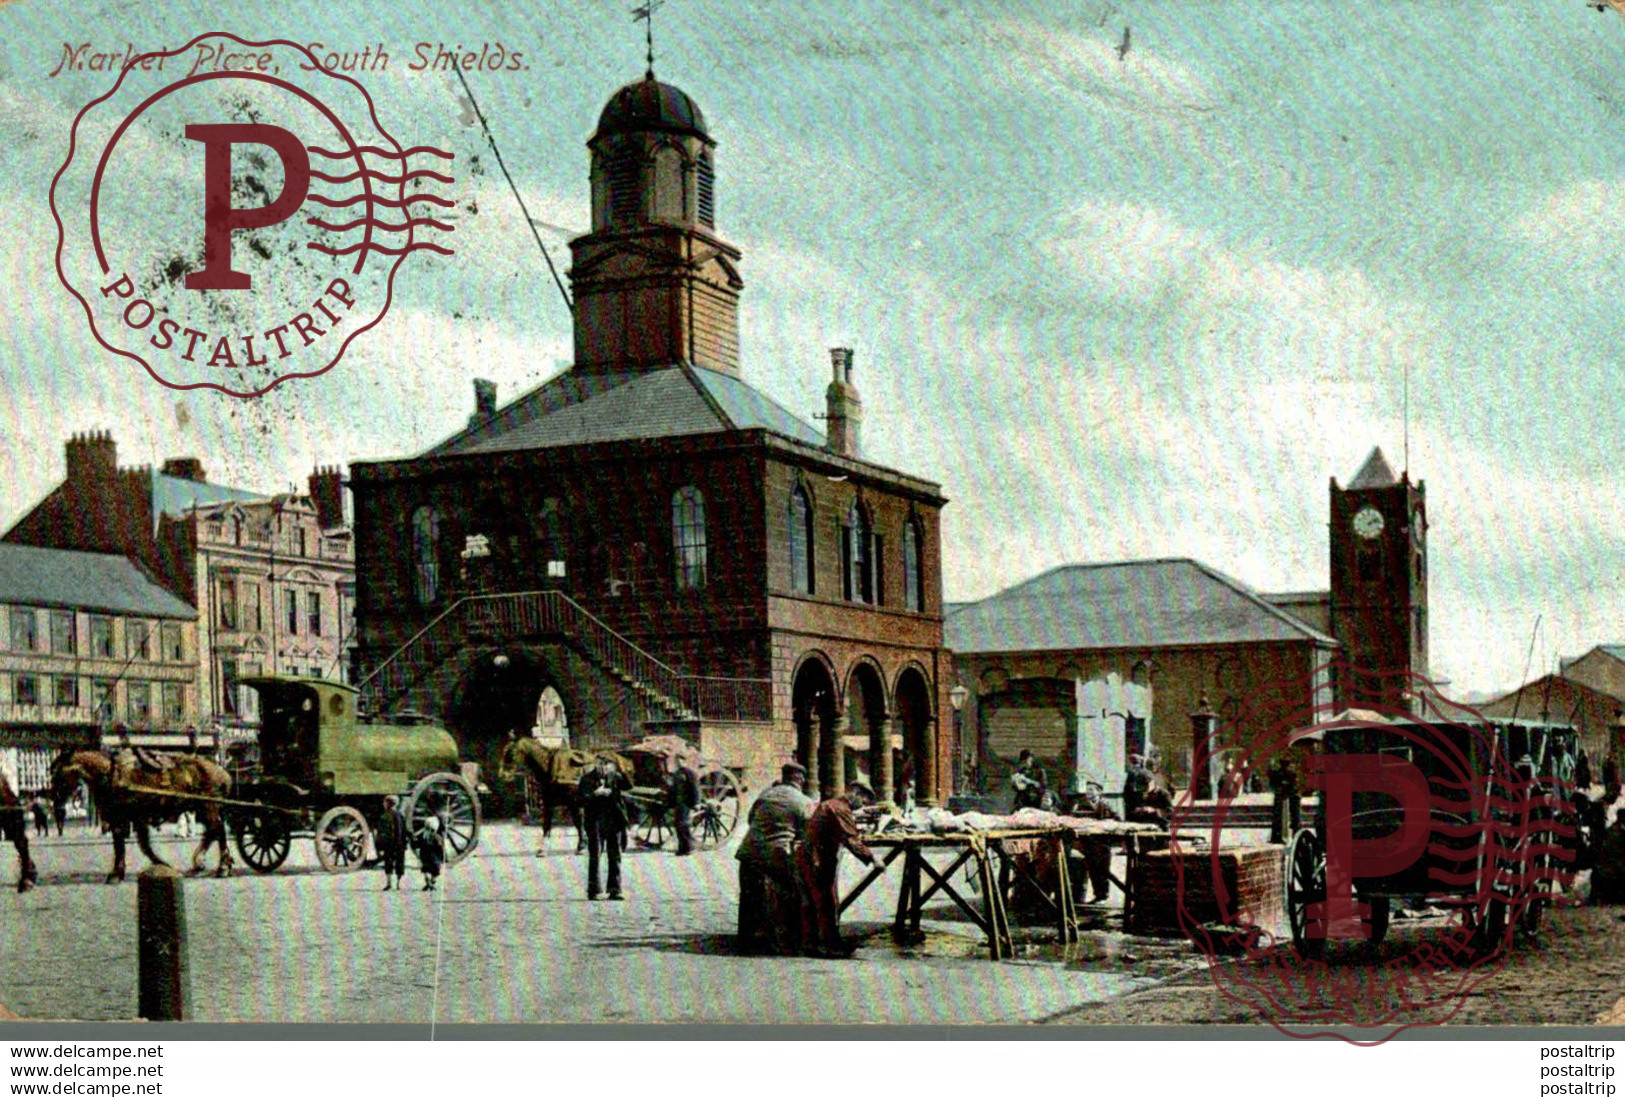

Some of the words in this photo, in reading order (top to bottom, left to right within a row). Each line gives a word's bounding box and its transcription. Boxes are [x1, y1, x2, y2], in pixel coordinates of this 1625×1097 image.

[49, 42, 168, 78] Market
[186, 43, 280, 78] Place,
[299, 42, 389, 71] South
[408, 42, 530, 71] Shields.
